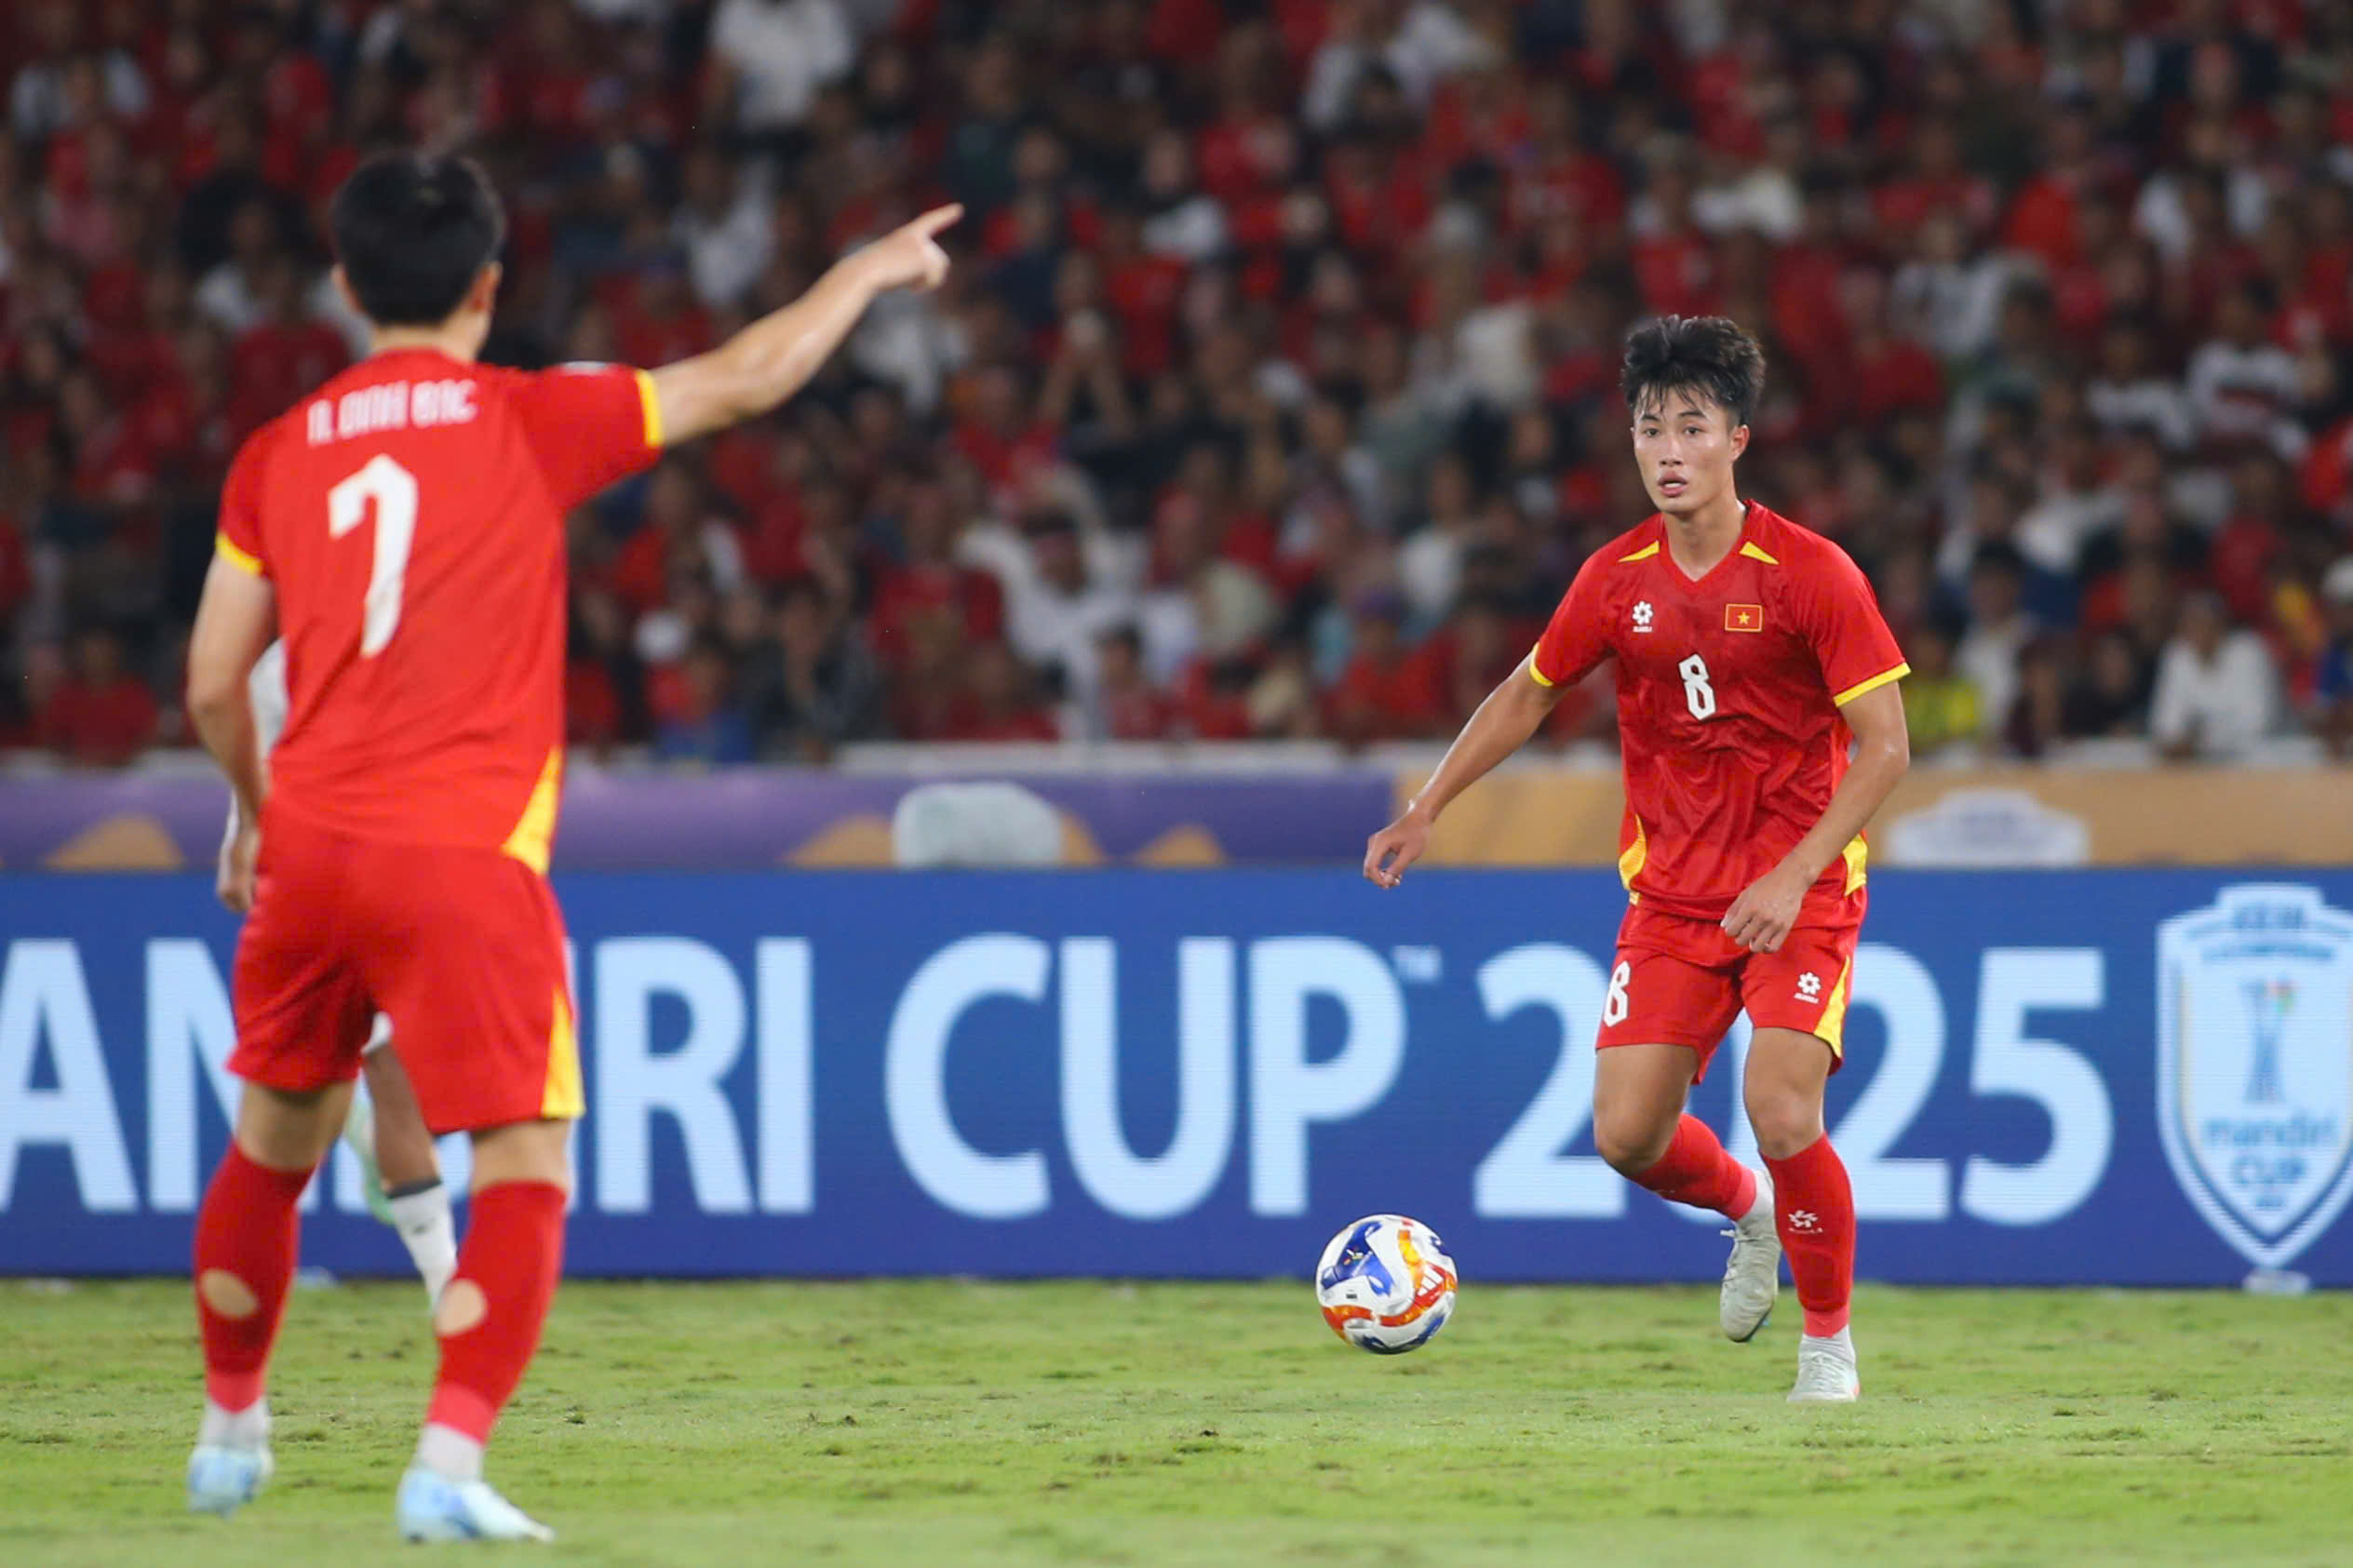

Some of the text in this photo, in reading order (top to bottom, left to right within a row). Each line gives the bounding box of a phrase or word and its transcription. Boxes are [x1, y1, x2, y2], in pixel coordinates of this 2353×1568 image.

[329, 453, 419, 657] 7
[1678, 653, 1716, 720] 8
[1603, 960, 1631, 1027] 8
[884, 931, 1407, 1218] CUP
[1473, 941, 2115, 1226] 225
